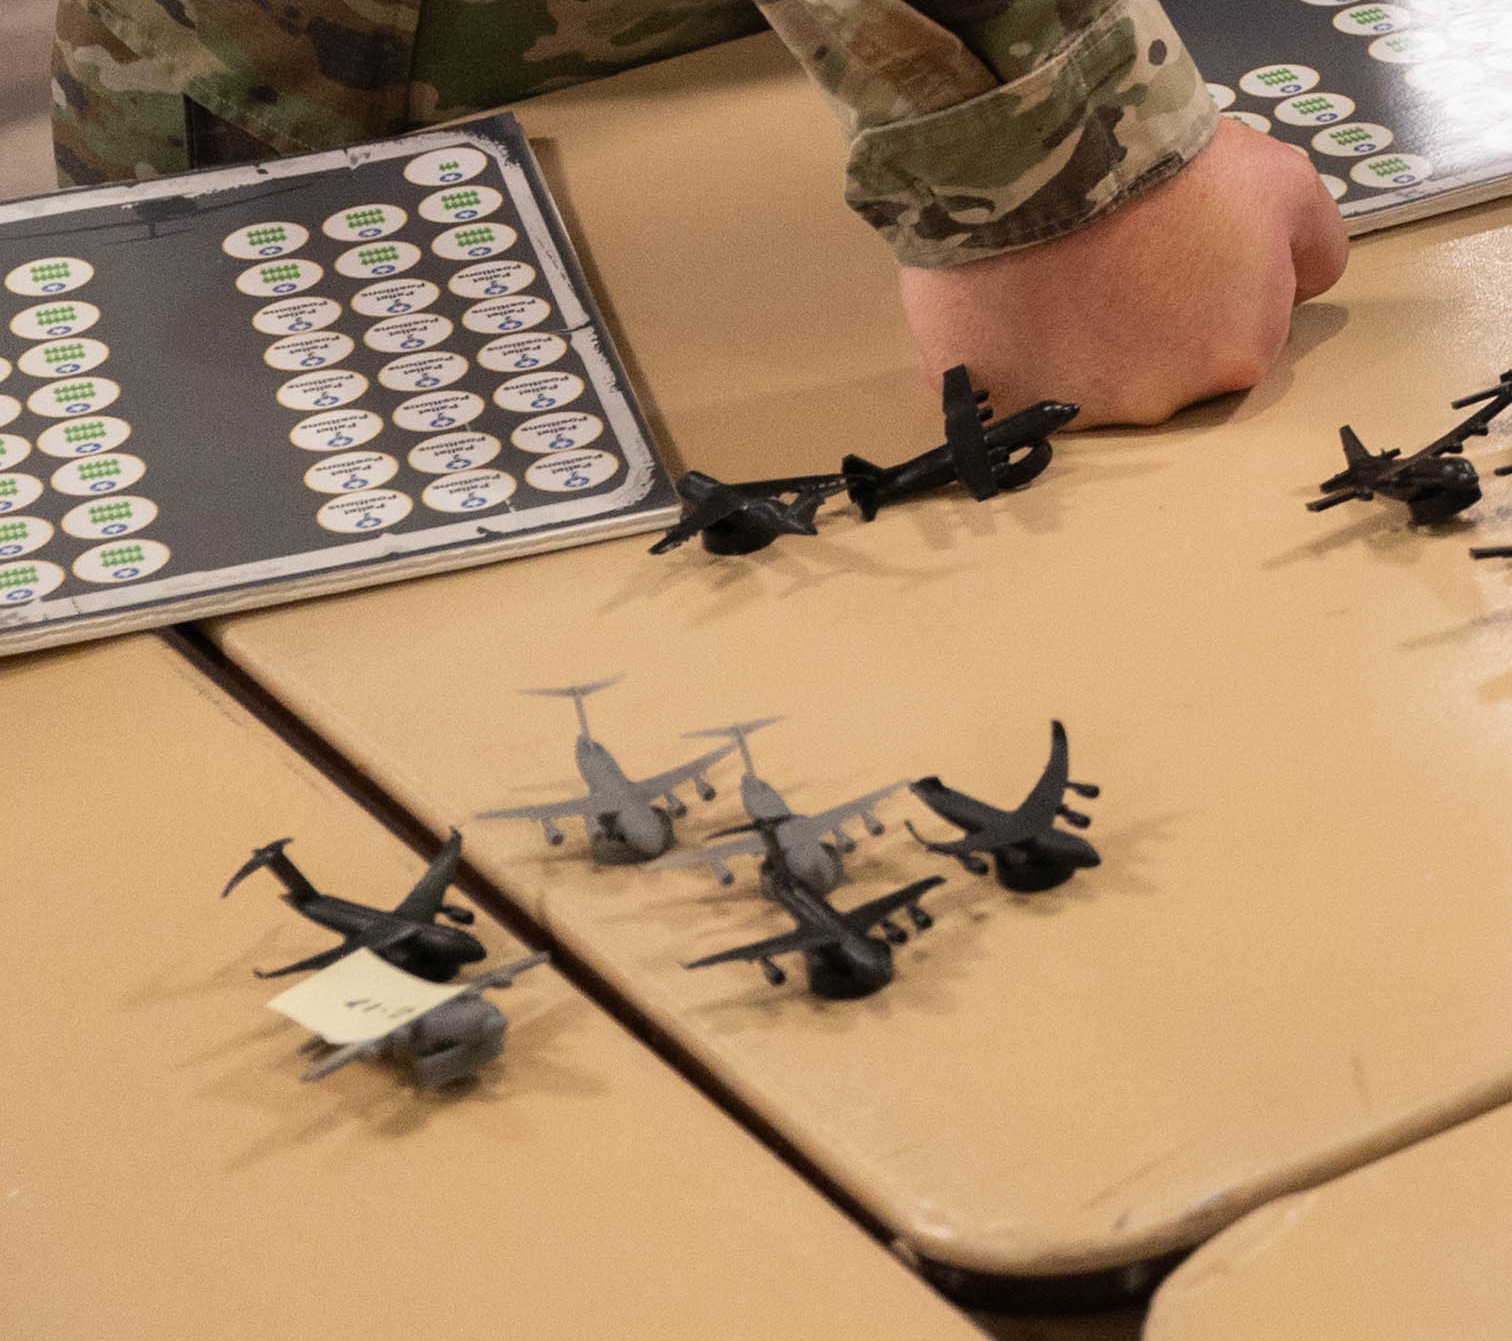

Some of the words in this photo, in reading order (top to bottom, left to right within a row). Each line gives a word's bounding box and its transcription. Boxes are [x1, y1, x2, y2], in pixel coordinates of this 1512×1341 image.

[503, 376, 569, 393] Positions
[521, 417, 587, 434] Positions
[537, 425, 577, 436] Pallet
[536, 454, 603, 471] Positions
[551, 463, 592, 474] Pallet
